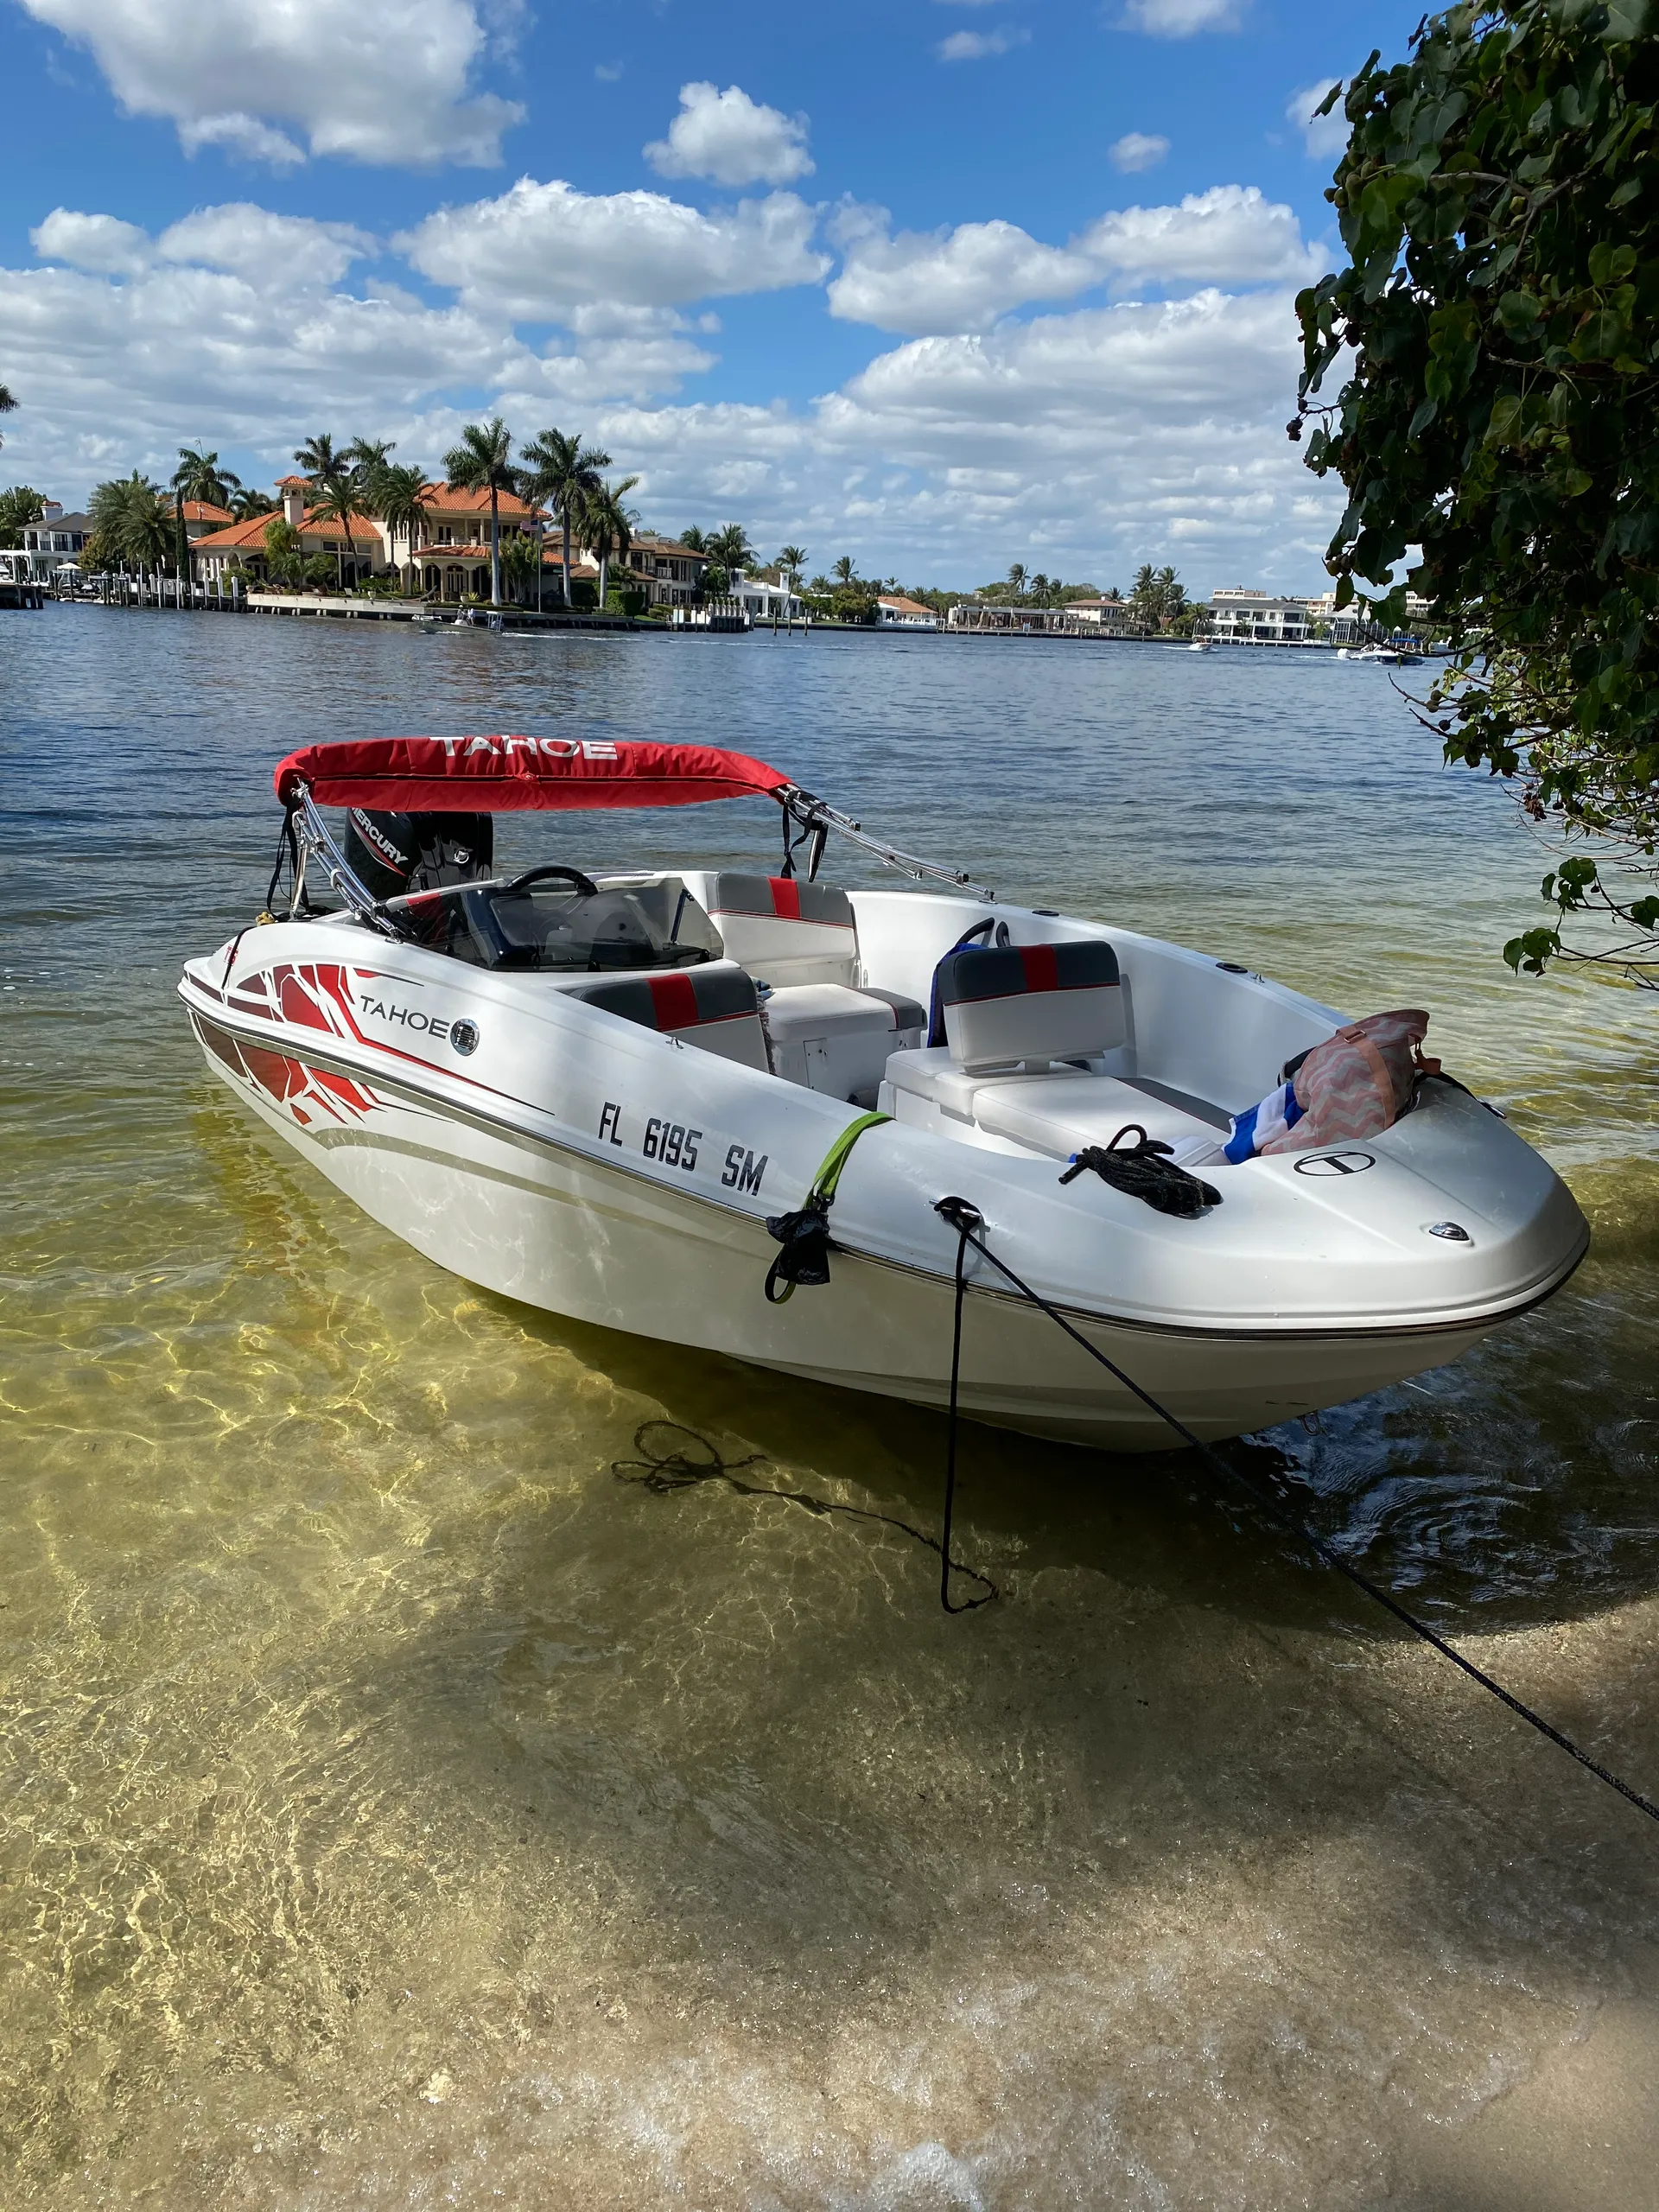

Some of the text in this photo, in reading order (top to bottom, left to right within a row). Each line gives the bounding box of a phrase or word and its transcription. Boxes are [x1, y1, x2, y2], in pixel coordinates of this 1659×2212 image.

[429, 735, 618, 760] TAHOE
[360, 995, 450, 1039] TAHOE
[598, 1101, 769, 1197] FL 6195 SM
